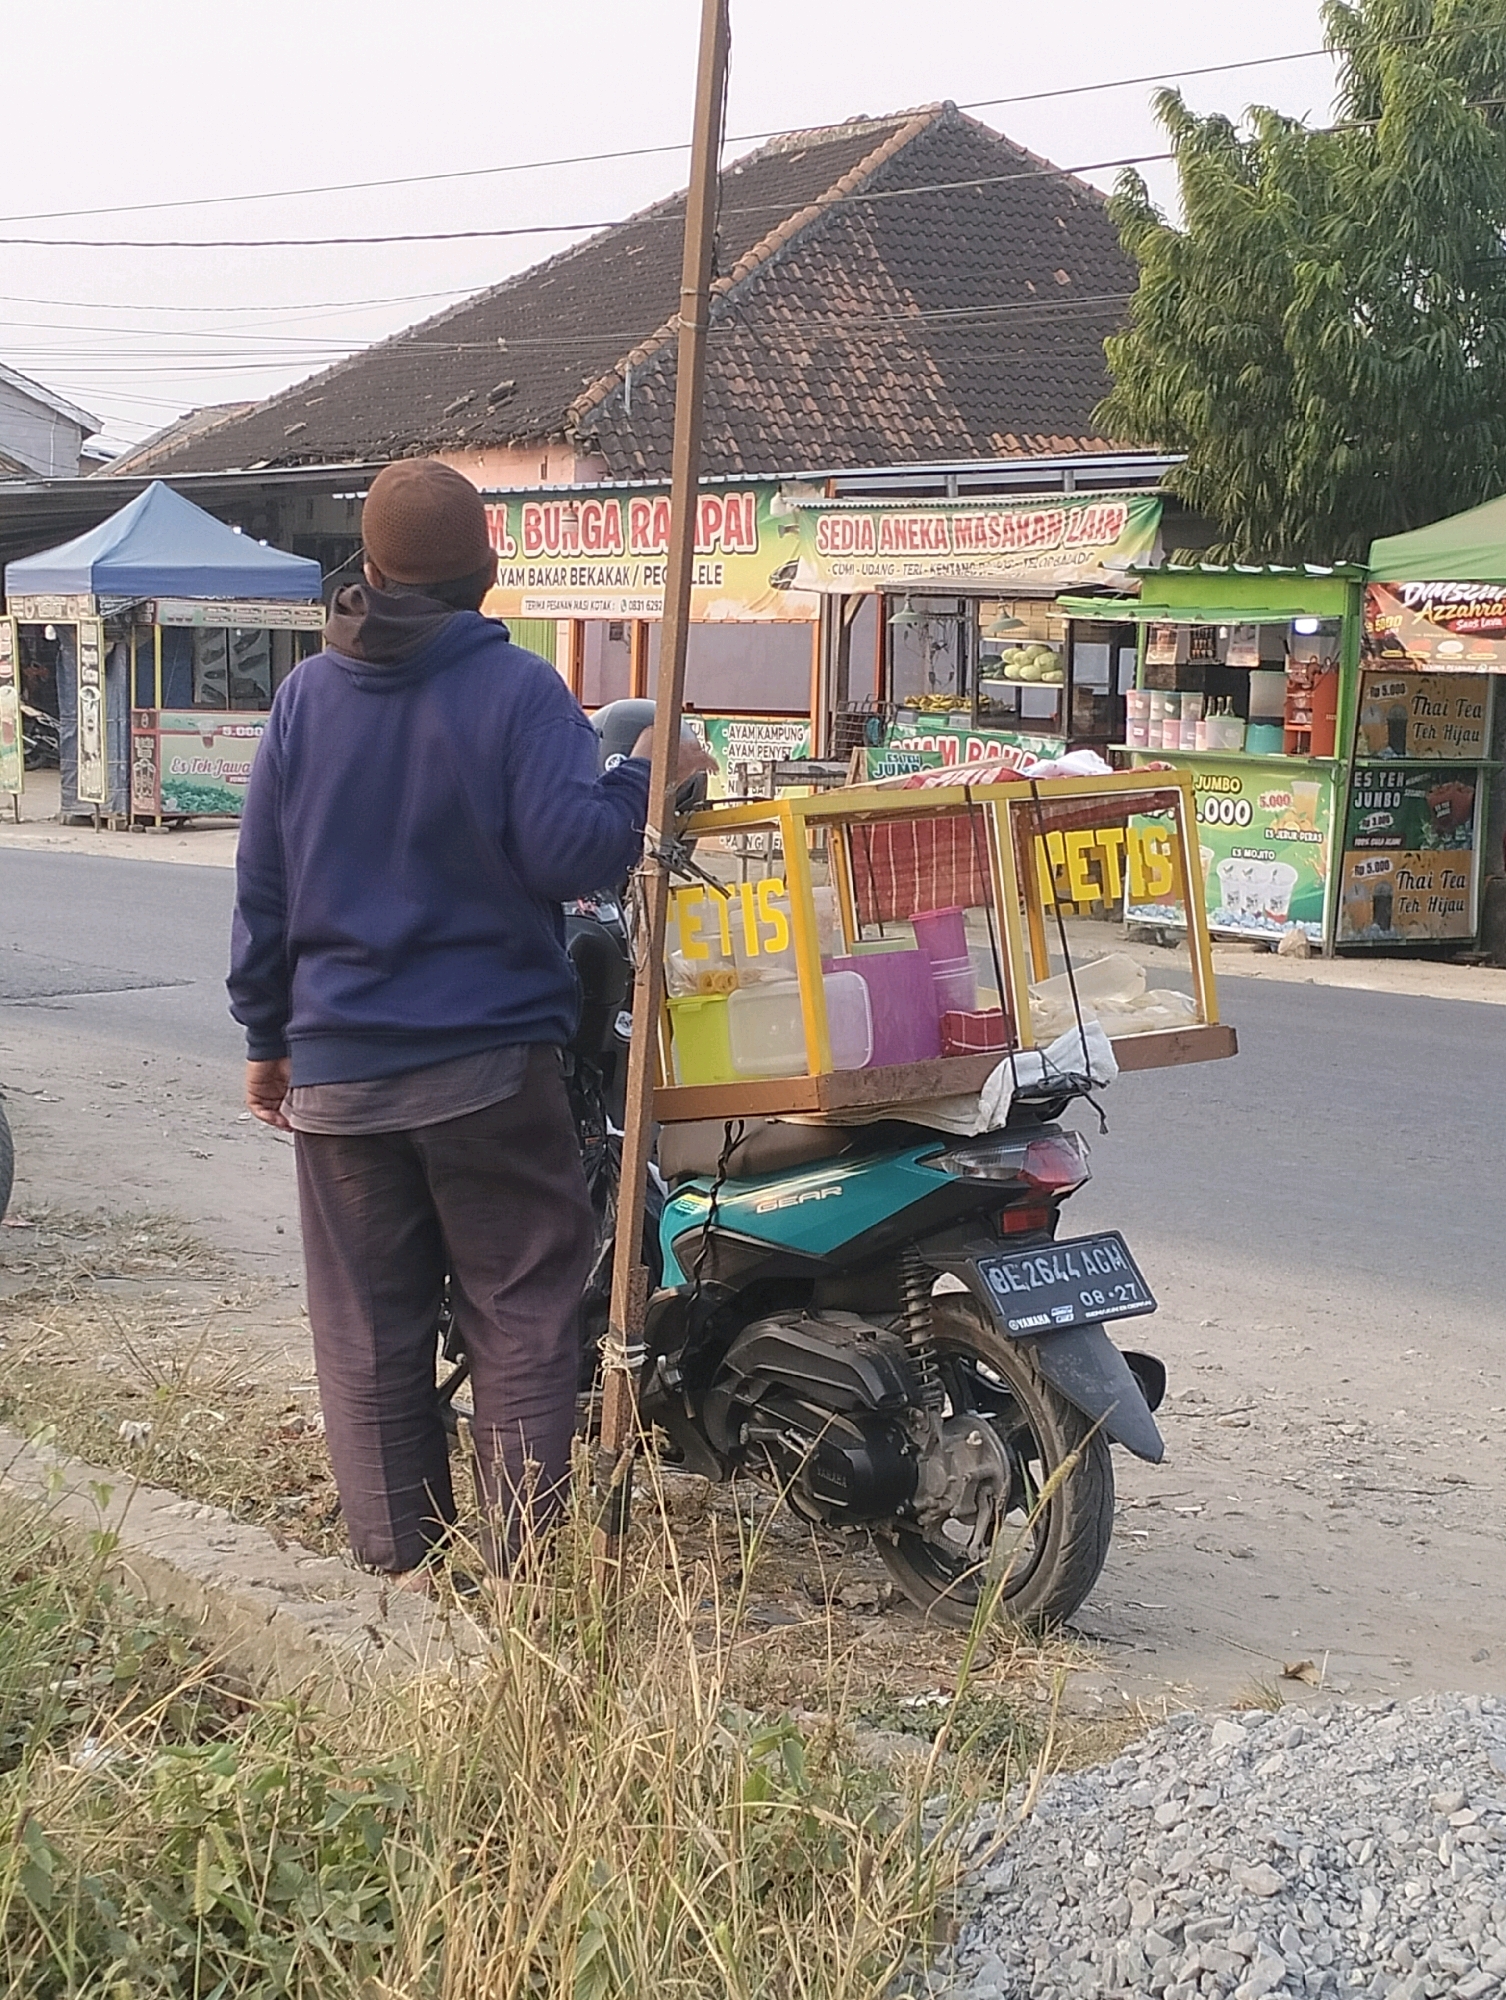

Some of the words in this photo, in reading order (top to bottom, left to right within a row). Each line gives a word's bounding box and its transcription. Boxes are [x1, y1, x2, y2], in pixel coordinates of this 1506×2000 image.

[631, 494, 755, 549] RAPAI
[817, 518, 874, 552] SEDIA
[880, 517, 948, 551] ANEKA
[953, 512, 1063, 550] MASAKAN
[1066, 507, 1126, 543] LAIN
[528, 566, 567, 587] BAKAR
[570, 565, 631, 587] BEKAKAK
[861, 563, 895, 576] UDANG
[1411, 599, 1506, 625] Azzahra
[1411, 695, 1449, 717] Thai
[1456, 698, 1482, 719] Tea
[728, 725, 755, 740] AYAM
[757, 725, 804, 742] KAMPUNG
[1412, 722, 1437, 739] Teh
[1443, 723, 1480, 747] Hijau
[728, 743, 755, 759] AYAM
[757, 745, 792, 760] PENYET
[190, 756, 211, 774] Teh
[1195, 775, 1242, 793] JUMBO
[1354, 771, 1373, 787] ES
[1379, 771, 1405, 788] TEH
[1354, 791, 1401, 808] JUMBO
[1243, 849, 1276, 860] MOJITO
[1366, 859, 1391, 874] 5.000
[1395, 870, 1433, 890] Thai
[1440, 869, 1466, 890] Tea
[1397, 896, 1420, 913] Teh
[1427, 896, 1465, 918] Hijau
[667, 878, 790, 960] ETIS
[756, 1186, 843, 1214] GEAR
